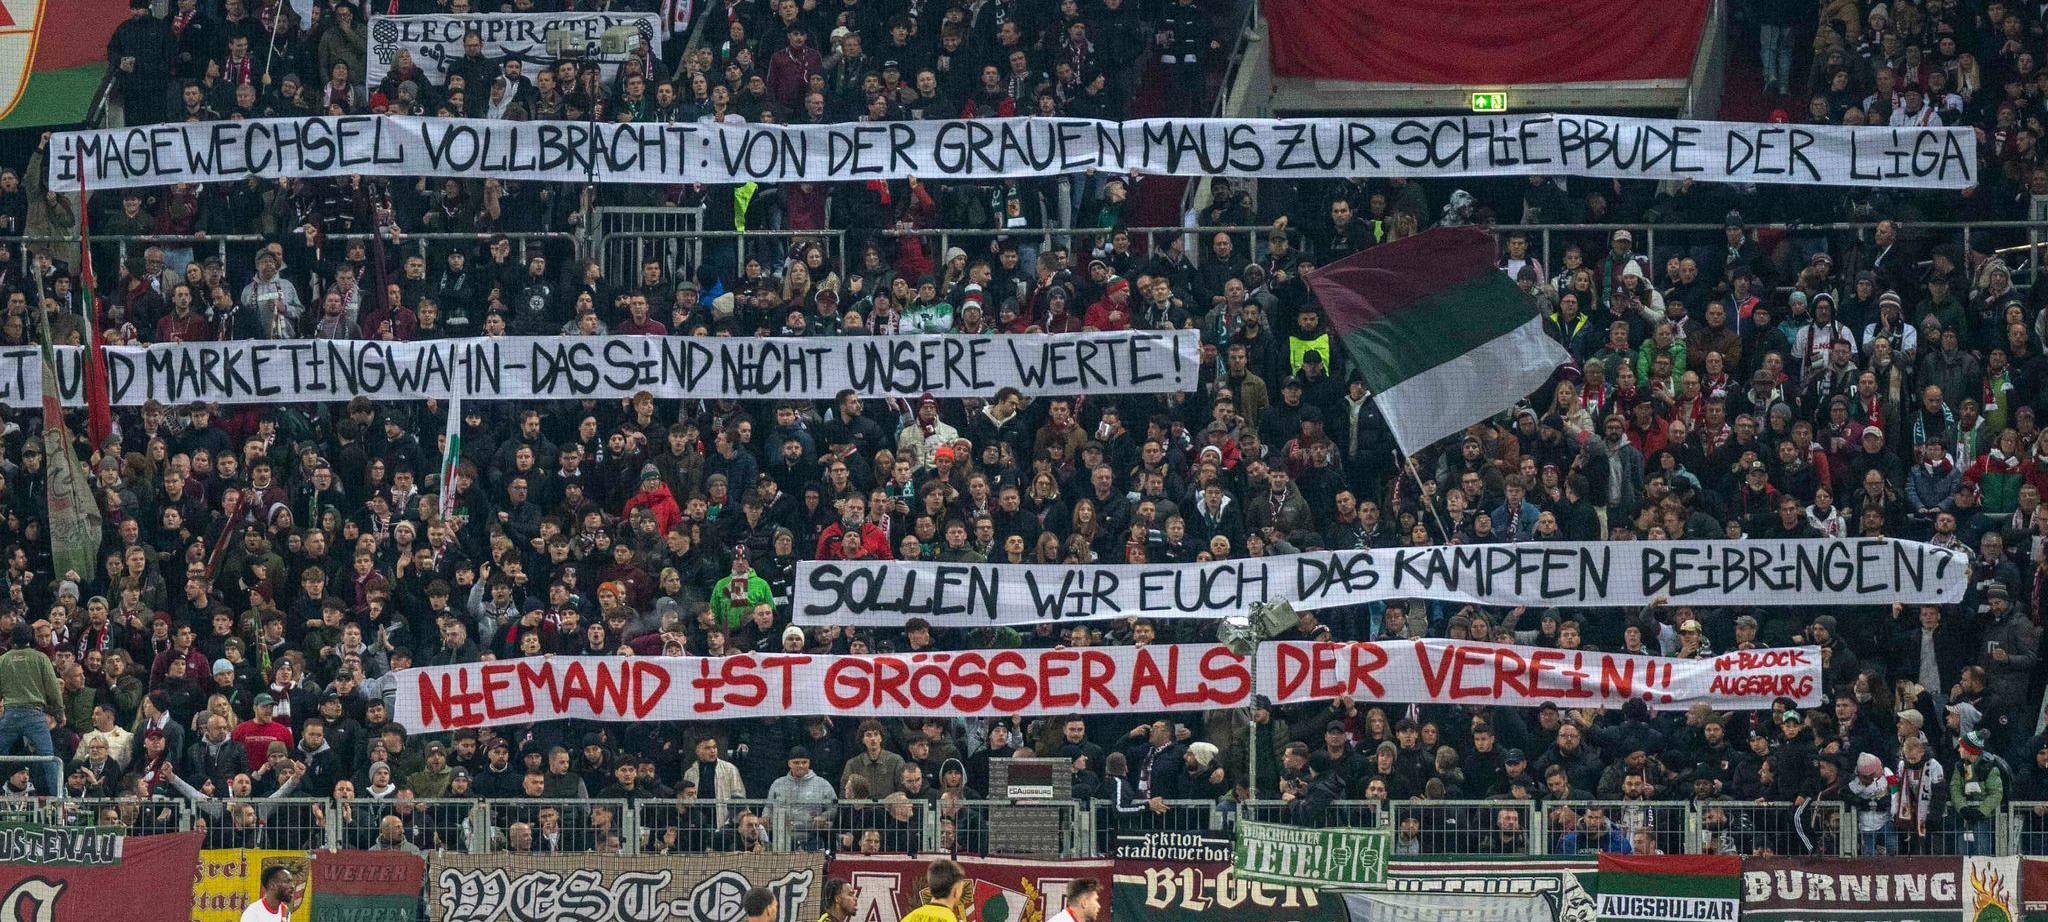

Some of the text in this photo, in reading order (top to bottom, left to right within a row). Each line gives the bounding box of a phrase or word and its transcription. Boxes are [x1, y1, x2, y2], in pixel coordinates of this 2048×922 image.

[719, 128, 807, 178] VON
[828, 123, 918, 177] DER
[933, 121, 1125, 175] GRAUEN
[1143, 121, 1265, 174] MAUS
[1272, 121, 1381, 170] ZUR
[1726, 127, 1822, 181] DER
[56, 347, 135, 405] UND
[846, 337, 995, 392] UNSERE
[1007, 335, 1183, 389] WERTE!
[804, 564, 998, 620] SOLLEN
[1139, 563, 1268, 613] EUCH
[1296, 550, 1380, 601] DAS
[1393, 546, 1611, 600] KÄMPFEN
[823, 651, 1121, 713] GRÖSSER
[1129, 643, 1252, 710] ALS
[1276, 642, 1389, 701] DER
[1709, 674, 1814, 699] AUGSBURG
[1243, 825, 1321, 845] DURCHHALTEN
[1243, 838, 1323, 879] TETE!
[191, 890, 249, 911] tatt
[1743, 869, 1956, 903] BURNING
[1601, 895, 1734, 920] AUGSBULGAR
